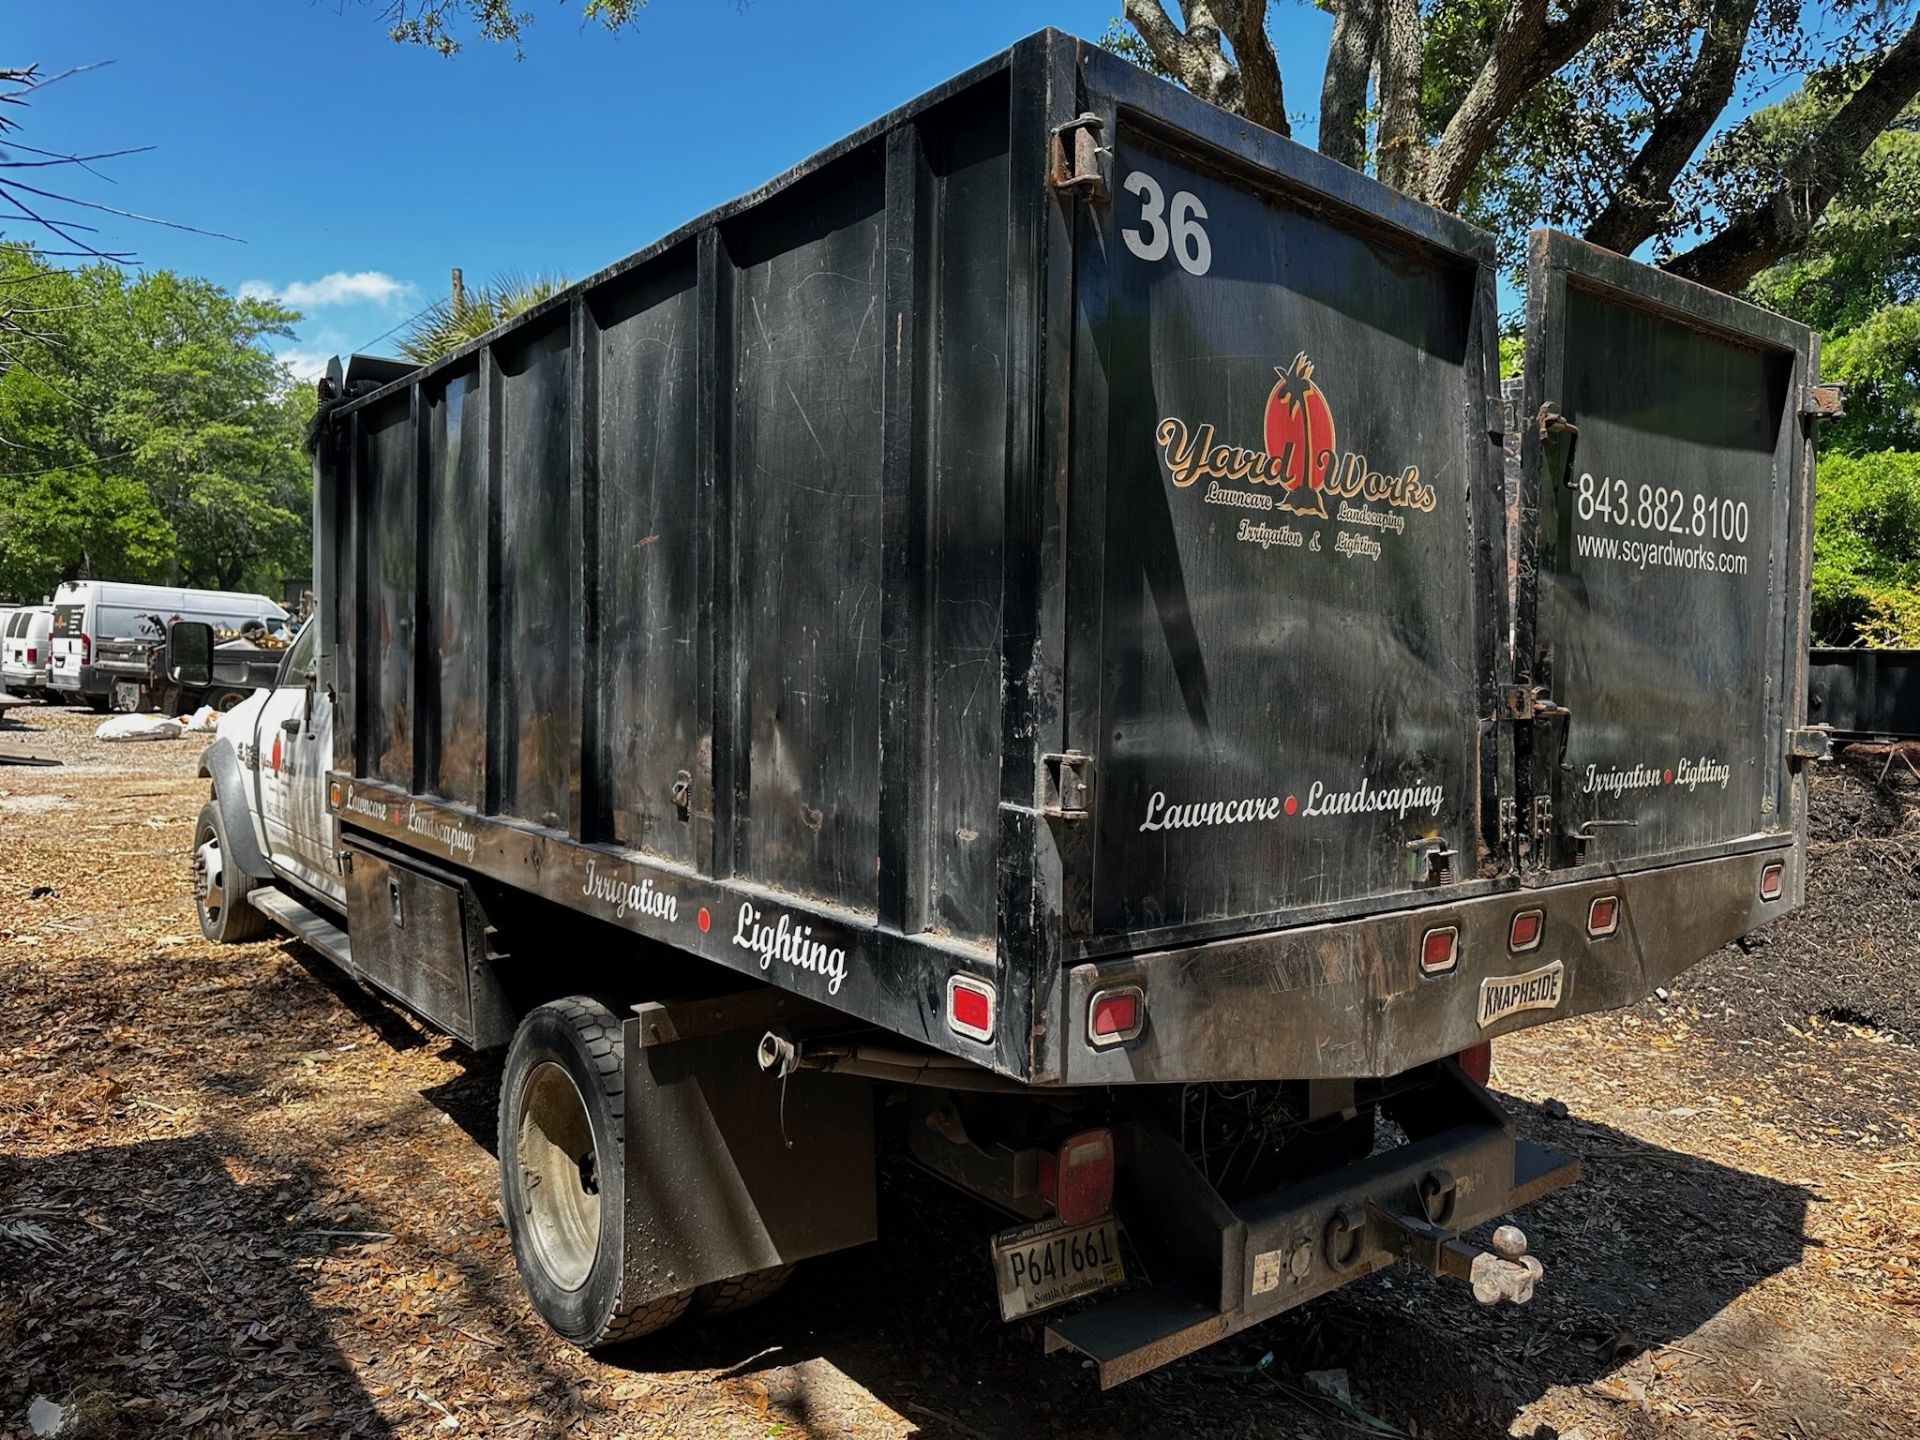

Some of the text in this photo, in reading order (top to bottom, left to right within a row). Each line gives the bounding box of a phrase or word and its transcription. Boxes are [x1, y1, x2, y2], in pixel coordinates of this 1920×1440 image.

[1121, 171, 1212, 277] 36
[1156, 417, 1437, 513] Yard Works
[1205, 480, 1405, 536] Lawncare Landscaping
[1577, 472, 1749, 543] 843.882.8100
[1237, 518, 1382, 562] Irrigation & Lighting
[1576, 534, 1748, 575] www.scyardworks.com
[1139, 777, 1445, 833] Lawncare Landscaping
[1582, 756, 1731, 800] Irrigation Lighting
[346, 784, 388, 822] Lawncare
[406, 802, 477, 864] Landscaping
[582, 858, 848, 996] Irrigation Lighting
[1483, 969, 1560, 1021] KNAPHEIDE
[1010, 1227, 1113, 1288] P647661
[1033, 1275, 1100, 1306] South Carolina
